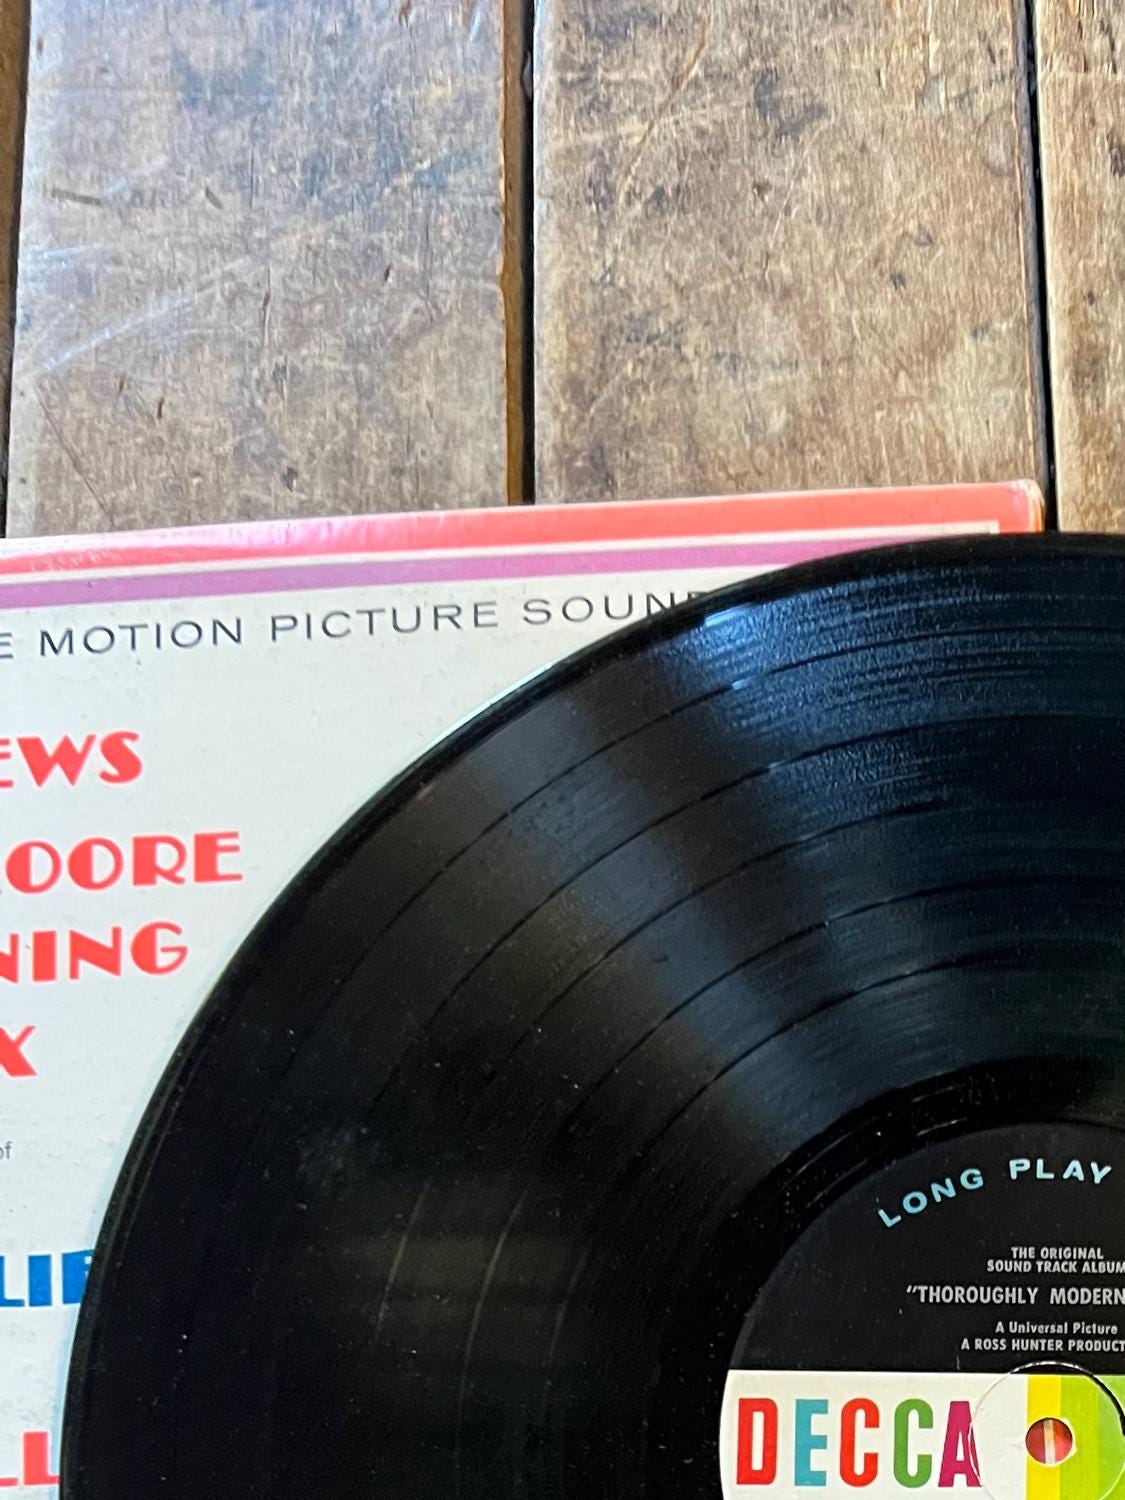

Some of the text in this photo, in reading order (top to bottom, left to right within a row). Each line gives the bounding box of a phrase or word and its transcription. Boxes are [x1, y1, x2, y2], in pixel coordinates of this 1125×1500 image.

[39, 616, 242, 656] MOTION
[270, 600, 498, 642] PICTURE
[523, 591, 710, 625] SOUN
[877, 1167, 985, 1228] LONG
[1009, 1158, 1112, 1184] PLAY
[1011, 1247, 1104, 1261] THE ORIGINAL
[987, 1260, 1032, 1273] SOUND
[1036, 1261, 1077, 1273] TRACK
[995, 1321, 1118, 1335] A Universal Picture
[961, 1337, 970, 1350] A
[974, 1338, 1007, 1351] ROSS
[1012, 1339, 1063, 1351] HUNTER
[736, 1398, 982, 1488] DECCA
